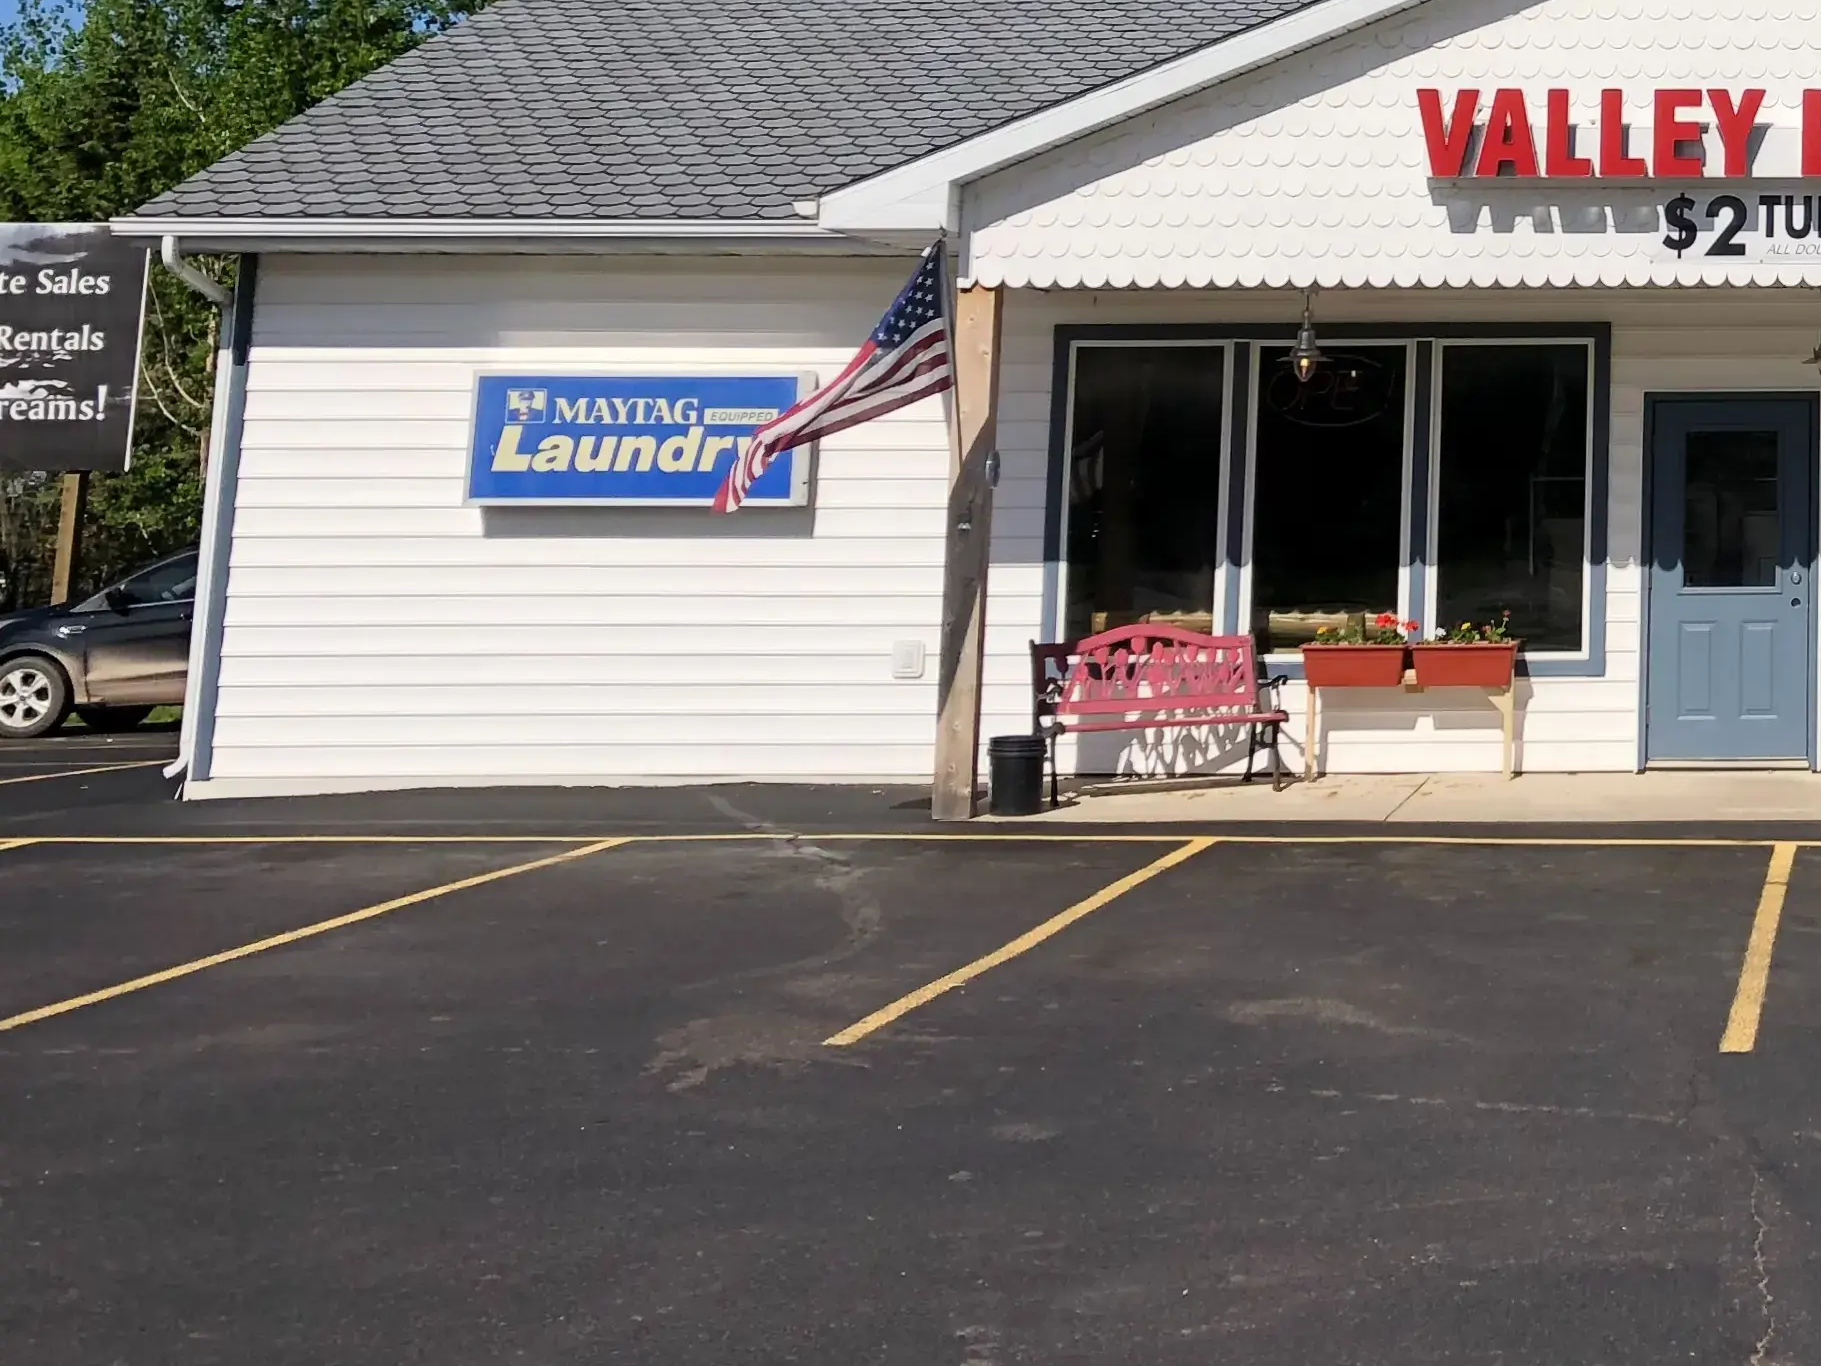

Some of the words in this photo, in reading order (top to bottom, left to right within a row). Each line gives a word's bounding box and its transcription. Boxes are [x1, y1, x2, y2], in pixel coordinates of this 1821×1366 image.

[1416, 88, 1767, 177] VALLEY
[1662, 192, 1748, 259] $2
[1766, 244, 1790, 255] ALL
[36, 268, 110, 295] Sales
[0, 324, 105, 351] Rentals
[552, 397, 699, 425] MAYTAG
[709, 410, 775, 423] EQUIPPED
